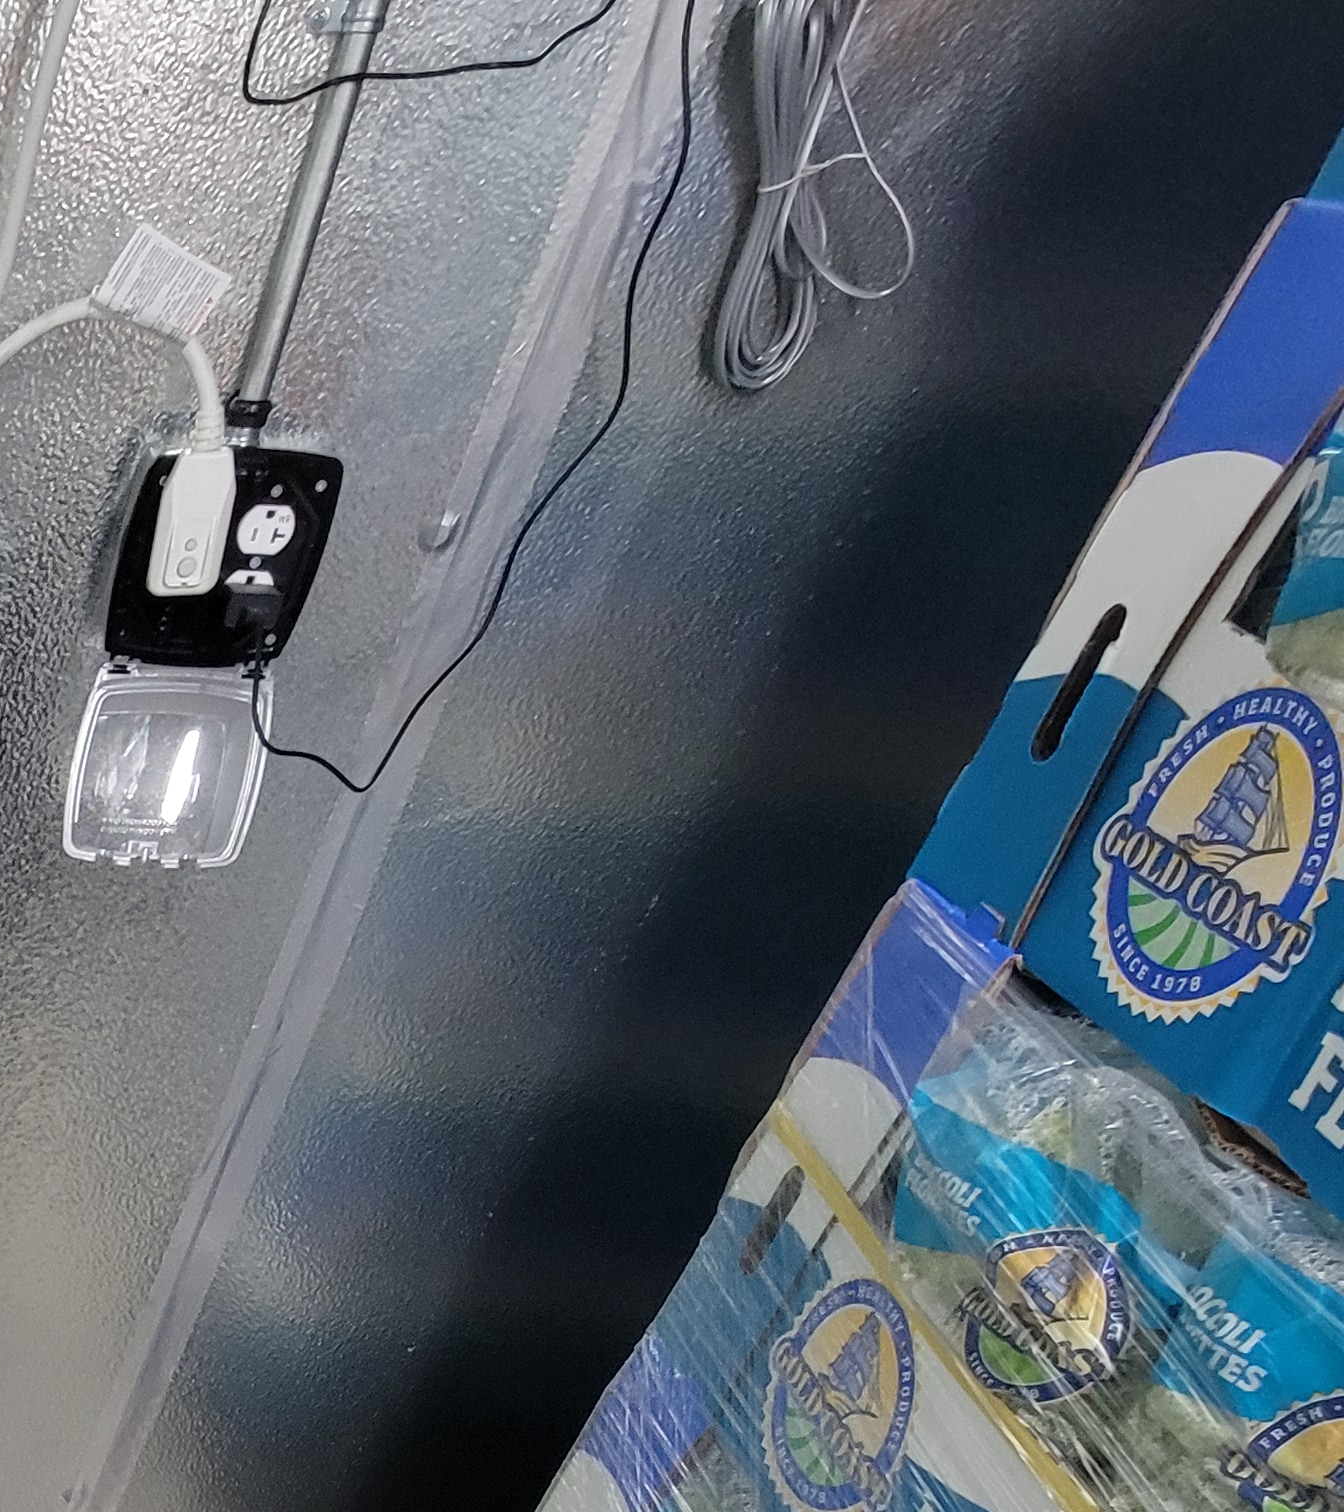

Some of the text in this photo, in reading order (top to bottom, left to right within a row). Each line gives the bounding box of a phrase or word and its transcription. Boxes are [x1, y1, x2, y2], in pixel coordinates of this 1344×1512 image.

[1146, 696, 1334, 888] FRESH HEALTHY PRODUCE
[1101, 822, 1309, 964] GOLD COAST
[1112, 922, 1154, 981] SINCE
[1258, 1403, 1324, 1450] FRESH
